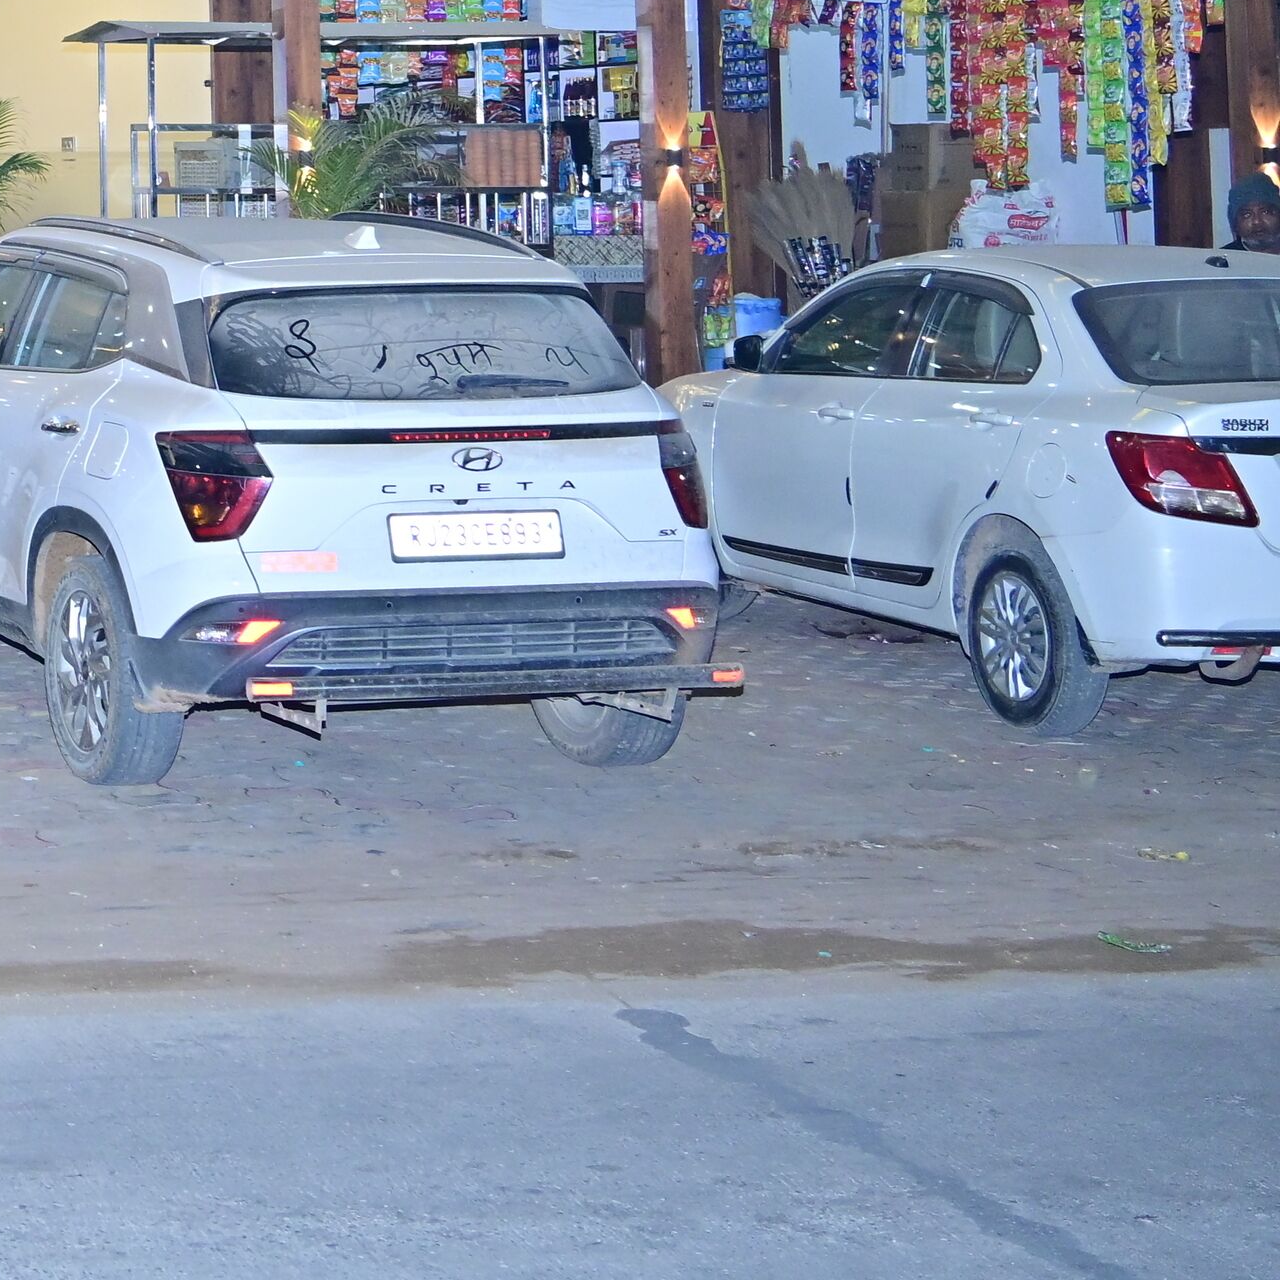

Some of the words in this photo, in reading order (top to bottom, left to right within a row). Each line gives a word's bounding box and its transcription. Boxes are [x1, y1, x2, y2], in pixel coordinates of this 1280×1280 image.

[1221, 424, 1269, 432] SUZUKI
[381, 480, 576, 494] CRETA
[658, 528, 678, 537] SX
